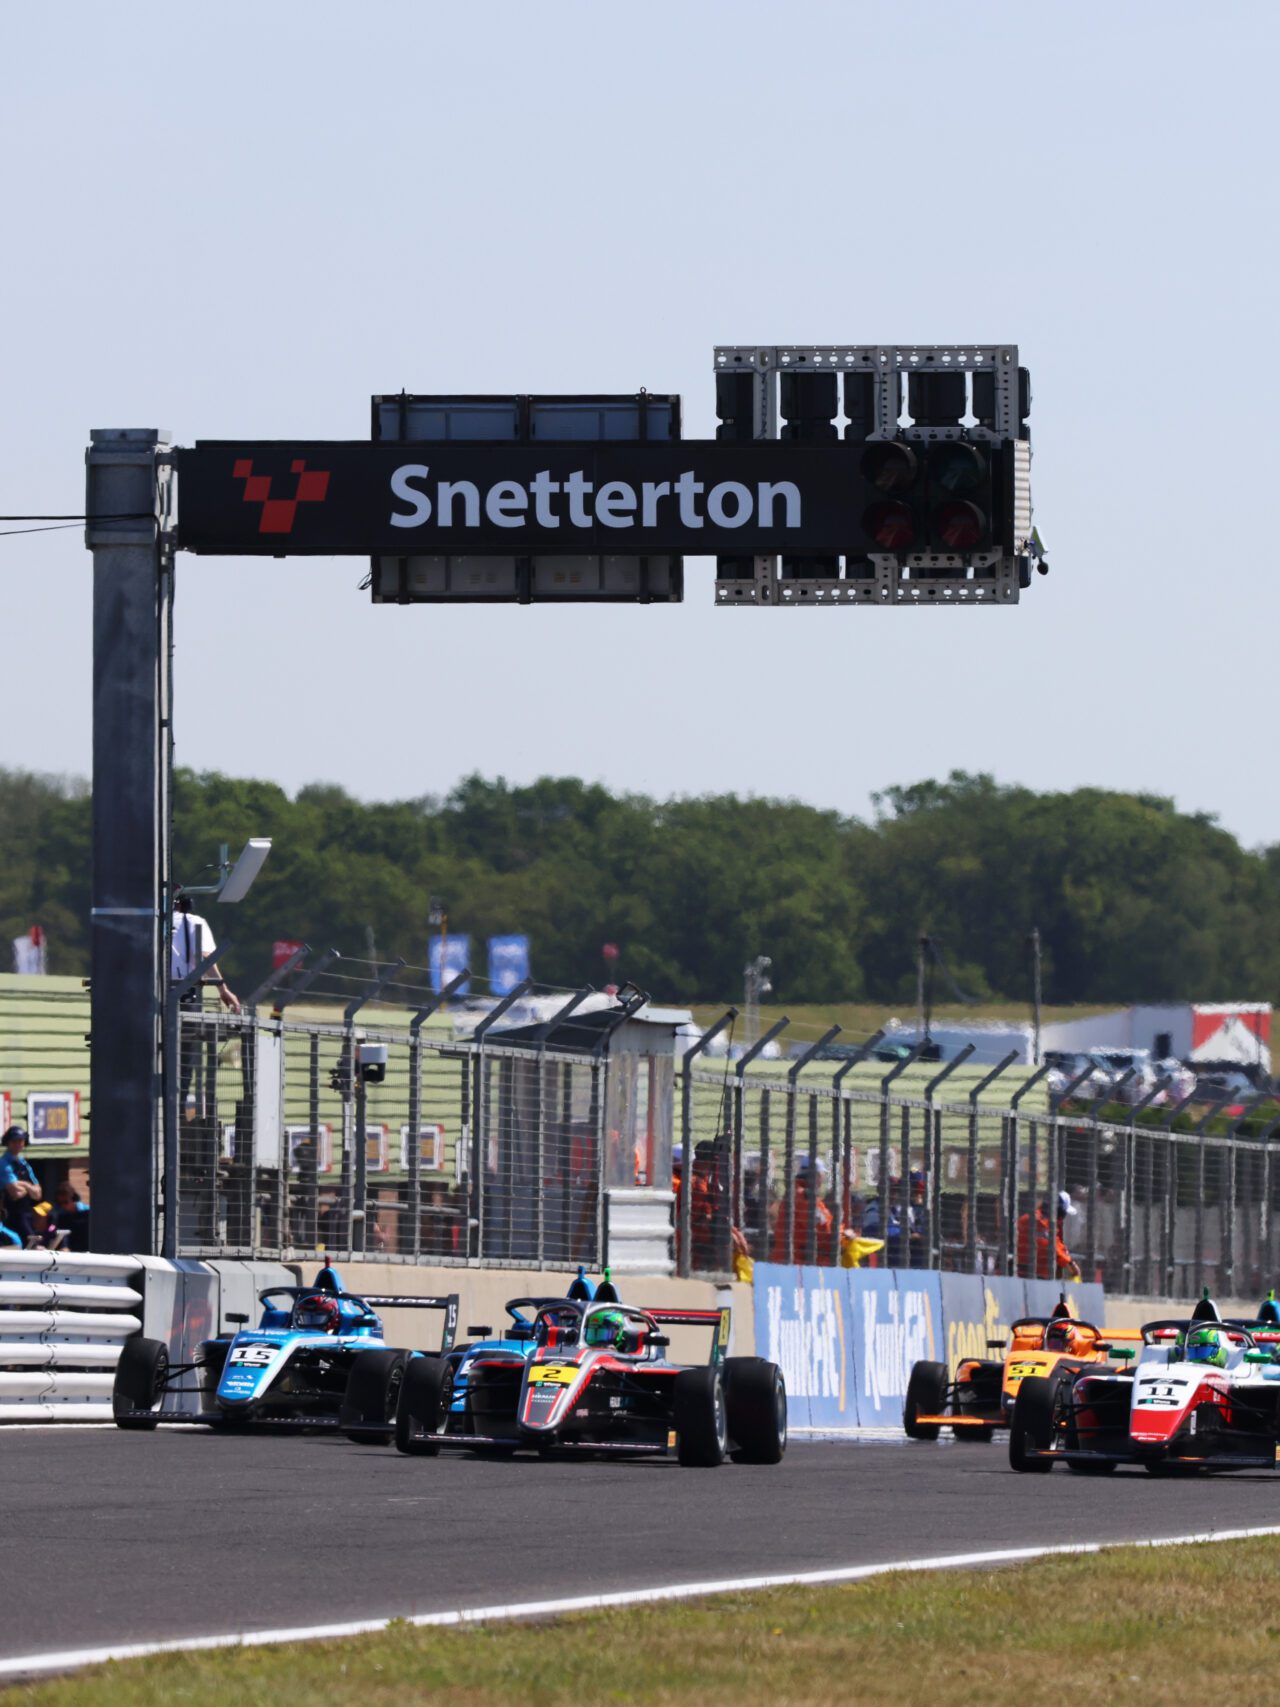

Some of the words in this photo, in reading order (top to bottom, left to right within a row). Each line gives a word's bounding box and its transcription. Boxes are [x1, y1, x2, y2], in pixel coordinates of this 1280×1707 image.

[389, 464, 802, 530] Snetterton
[234, 1350, 272, 1360] 15
[543, 1368, 562, 1379] 2
[1011, 1366, 1037, 1375] 51
[1146, 1386, 1175, 1396] 11
